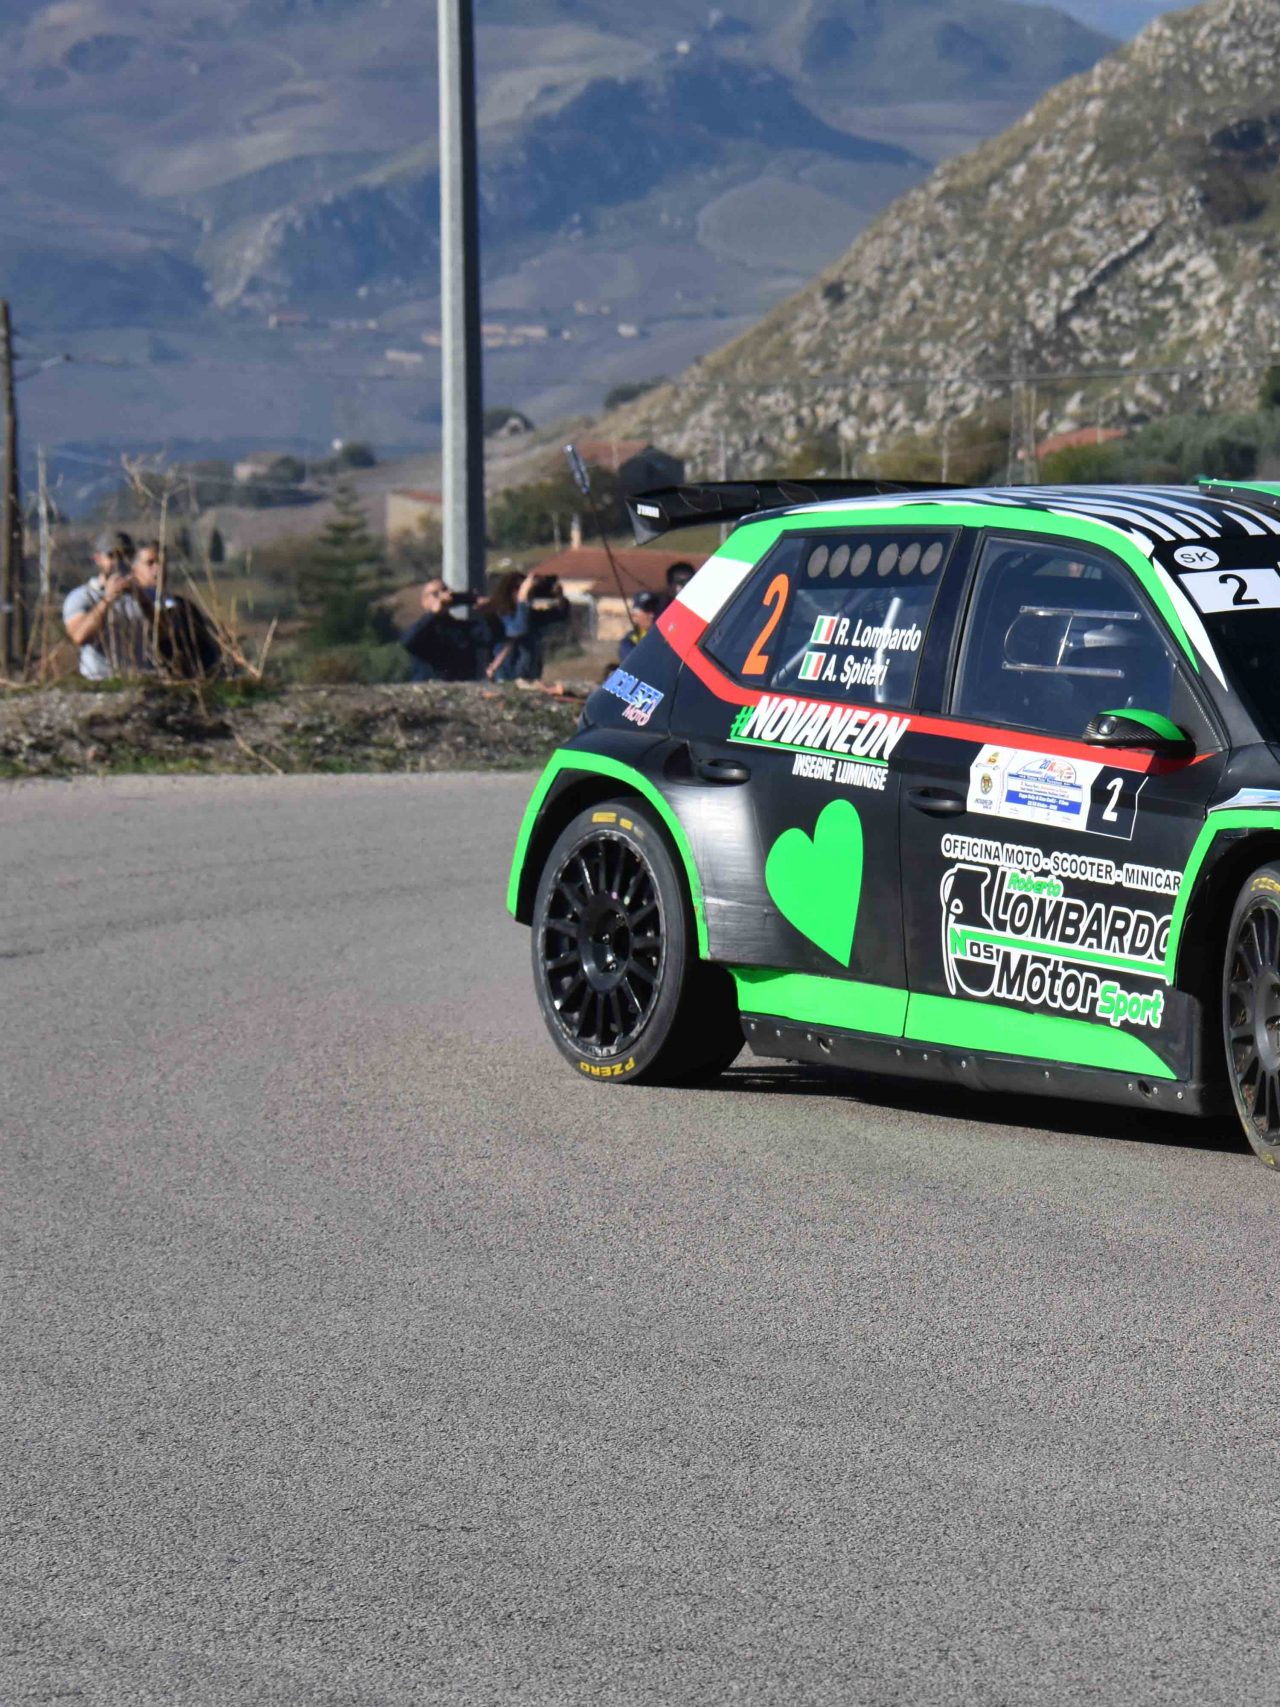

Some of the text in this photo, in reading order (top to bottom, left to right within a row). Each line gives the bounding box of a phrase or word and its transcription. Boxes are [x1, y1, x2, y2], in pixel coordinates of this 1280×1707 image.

[1180, 551, 1214, 563] SK
[1218, 573, 1260, 606] 2
[741, 573, 789, 675] 2
[834, 617, 922, 652] R. Lombardo
[822, 654, 891, 690] A. Spiteri
[730, 695, 911, 760] #NOVANEON
[792, 754, 889, 791] INSEGNE LUMINOSE
[1102, 777, 1124, 822] 2
[943, 837, 1000, 862] OFFICINA
[1005, 847, 1041, 868] MOTO
[1052, 856, 1113, 880] SCOOTER
[1125, 868, 1181, 891] MINICAR
[1008, 873, 1062, 897] Roberto
